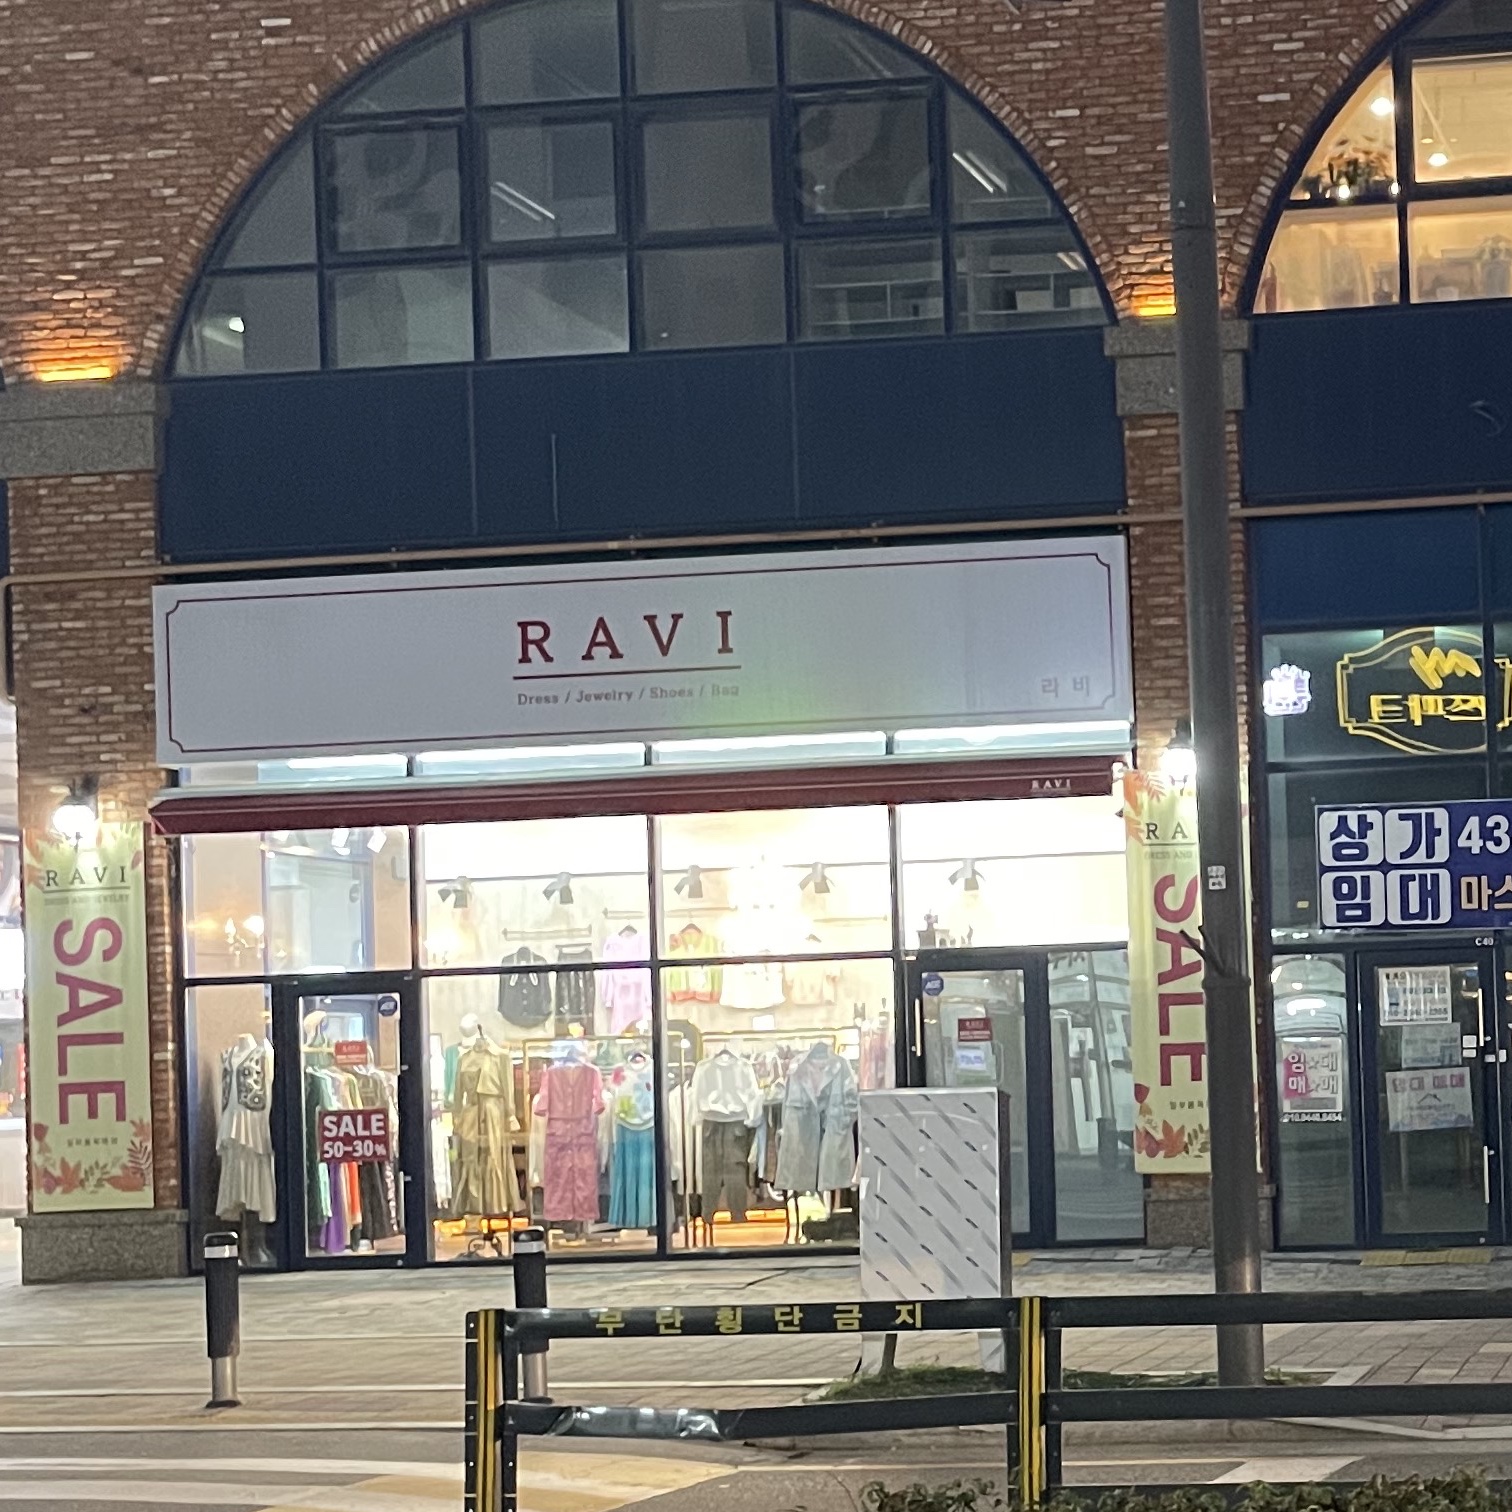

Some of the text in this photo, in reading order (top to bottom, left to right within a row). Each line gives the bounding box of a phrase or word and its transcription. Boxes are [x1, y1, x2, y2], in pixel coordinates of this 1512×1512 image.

[517, 610, 734, 664] RAVI
[517, 692, 559, 706] Dress
[576, 689, 633, 704] Jewelry
[649, 685, 694, 699] Shoes
[1145, 821, 1189, 840] RA
[1329, 812, 1442, 863] 상가
[45, 866, 126, 887] RAVI
[1332, 874, 1442, 925] 임대
[1153, 873, 1206, 1086] SALE
[53, 917, 126, 1125] SALE
[323, 1113, 386, 1139] SALE
